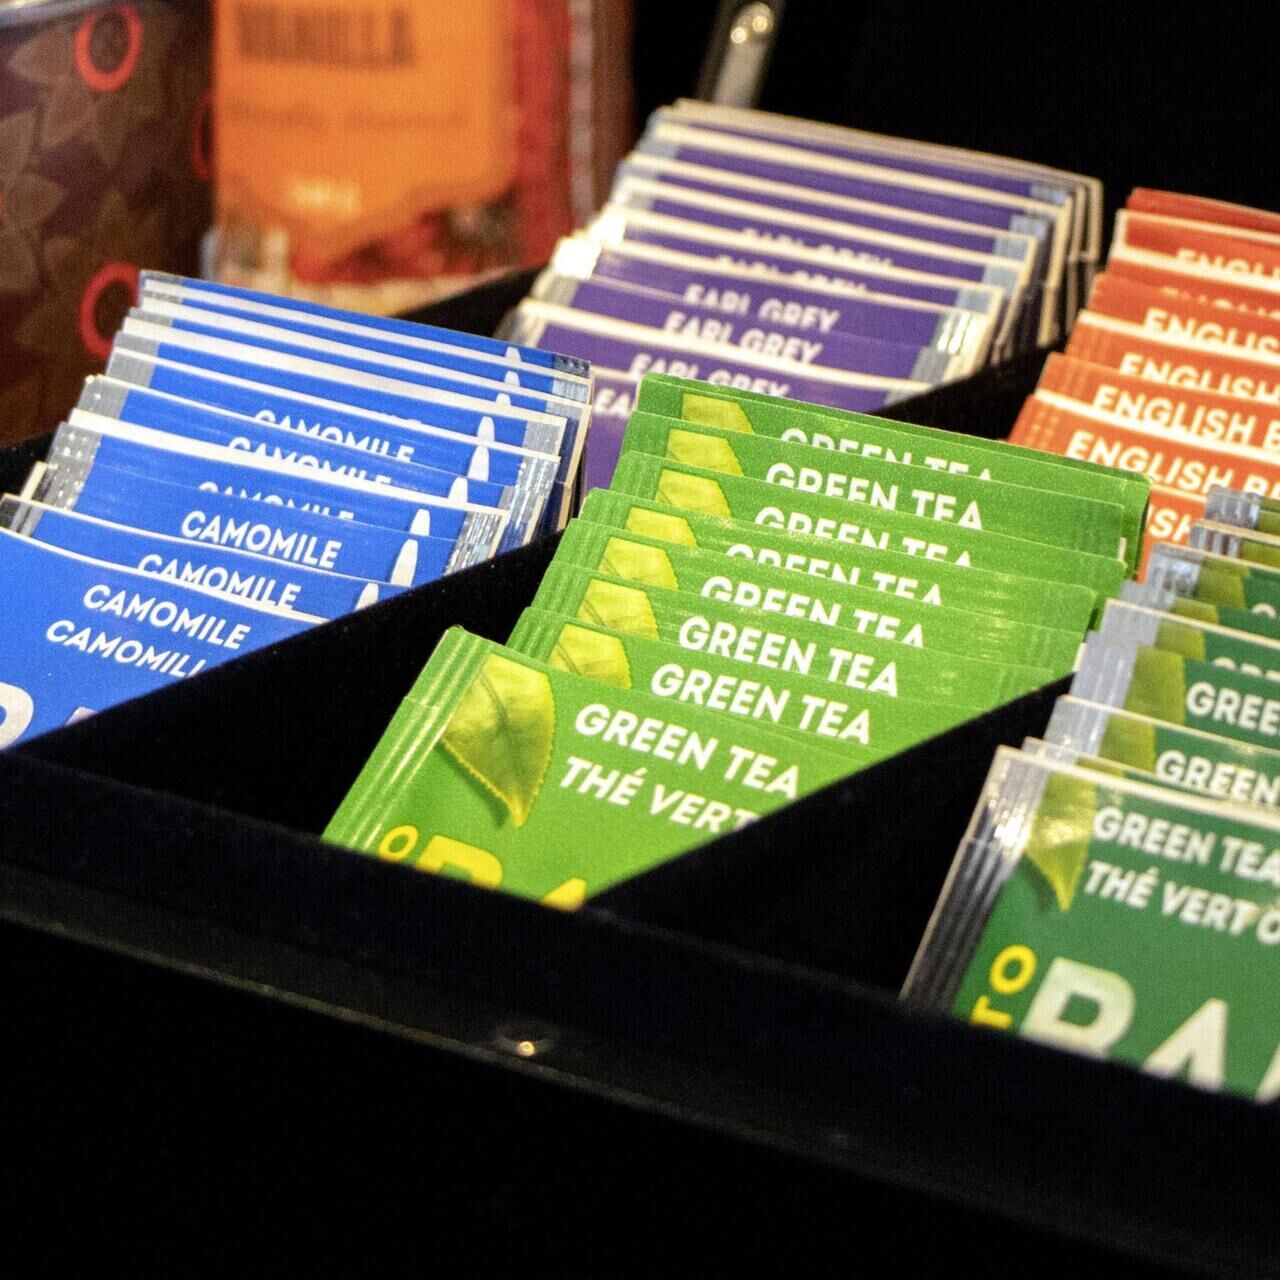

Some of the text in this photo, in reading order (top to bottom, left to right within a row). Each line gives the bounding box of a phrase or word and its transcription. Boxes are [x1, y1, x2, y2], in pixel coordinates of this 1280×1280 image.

[1092, 384, 1254, 445] ENGLISH
[181, 510, 343, 569] CAMOMILE
[911, 488, 983, 531] TEA
[138, 554, 302, 611] CAMOMILE
[83, 584, 252, 651] CAMOMILE
[853, 608, 924, 649] TEA
[678, 614, 899, 697] GREEN TEA
[651, 662, 871, 745] GREEN TEA
[574, 702, 801, 800] GREEN TEA
[559, 755, 761, 835] THÉ VERT
[1092, 807, 1217, 867] GREEN
[1083, 860, 1161, 910] THÉ
[1161, 882, 1261, 936] VERT
